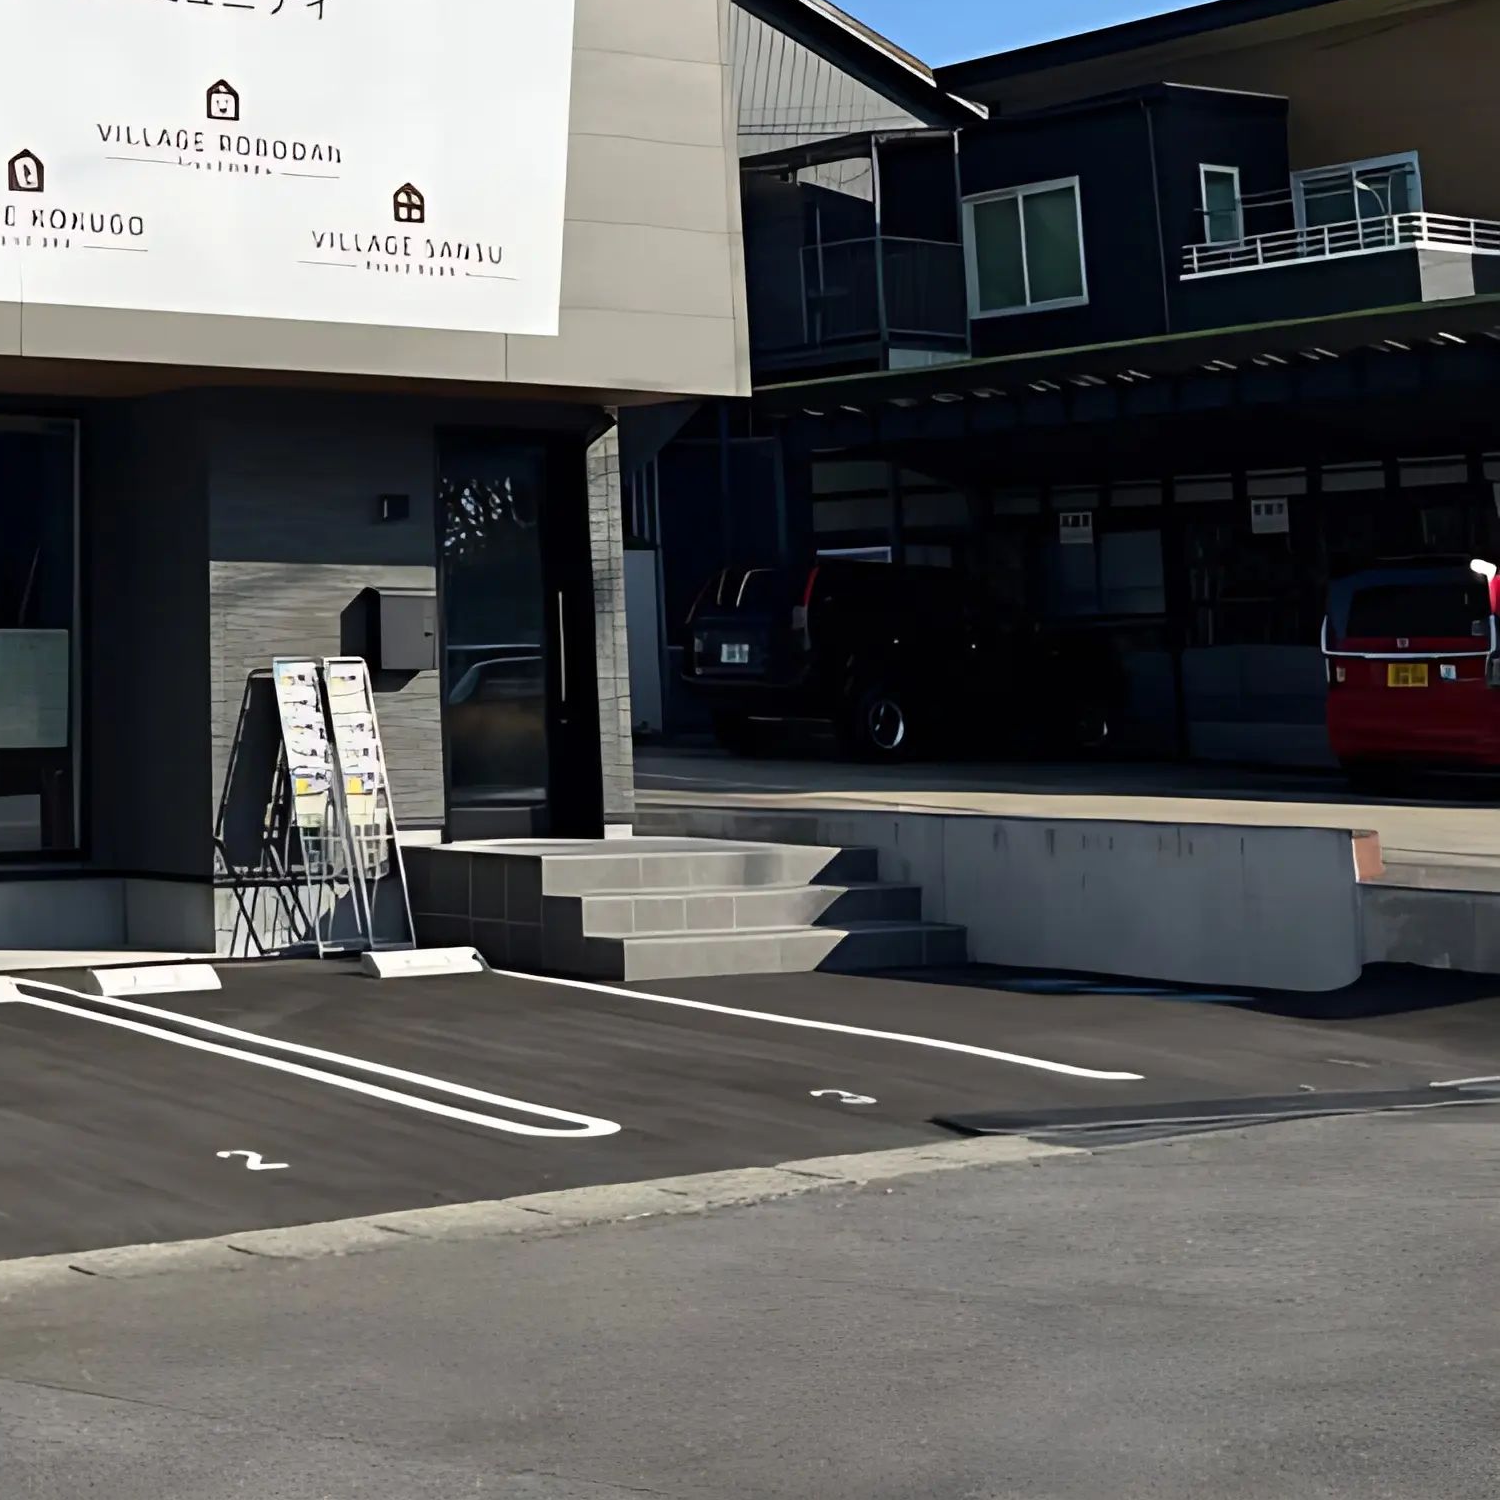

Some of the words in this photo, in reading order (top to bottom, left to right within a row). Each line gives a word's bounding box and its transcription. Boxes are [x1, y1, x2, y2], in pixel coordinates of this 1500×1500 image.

[96, 123, 204, 153] VILLAGE
[311, 230, 412, 257] VILLAGE
[216, 1149, 289, 1171] 2
